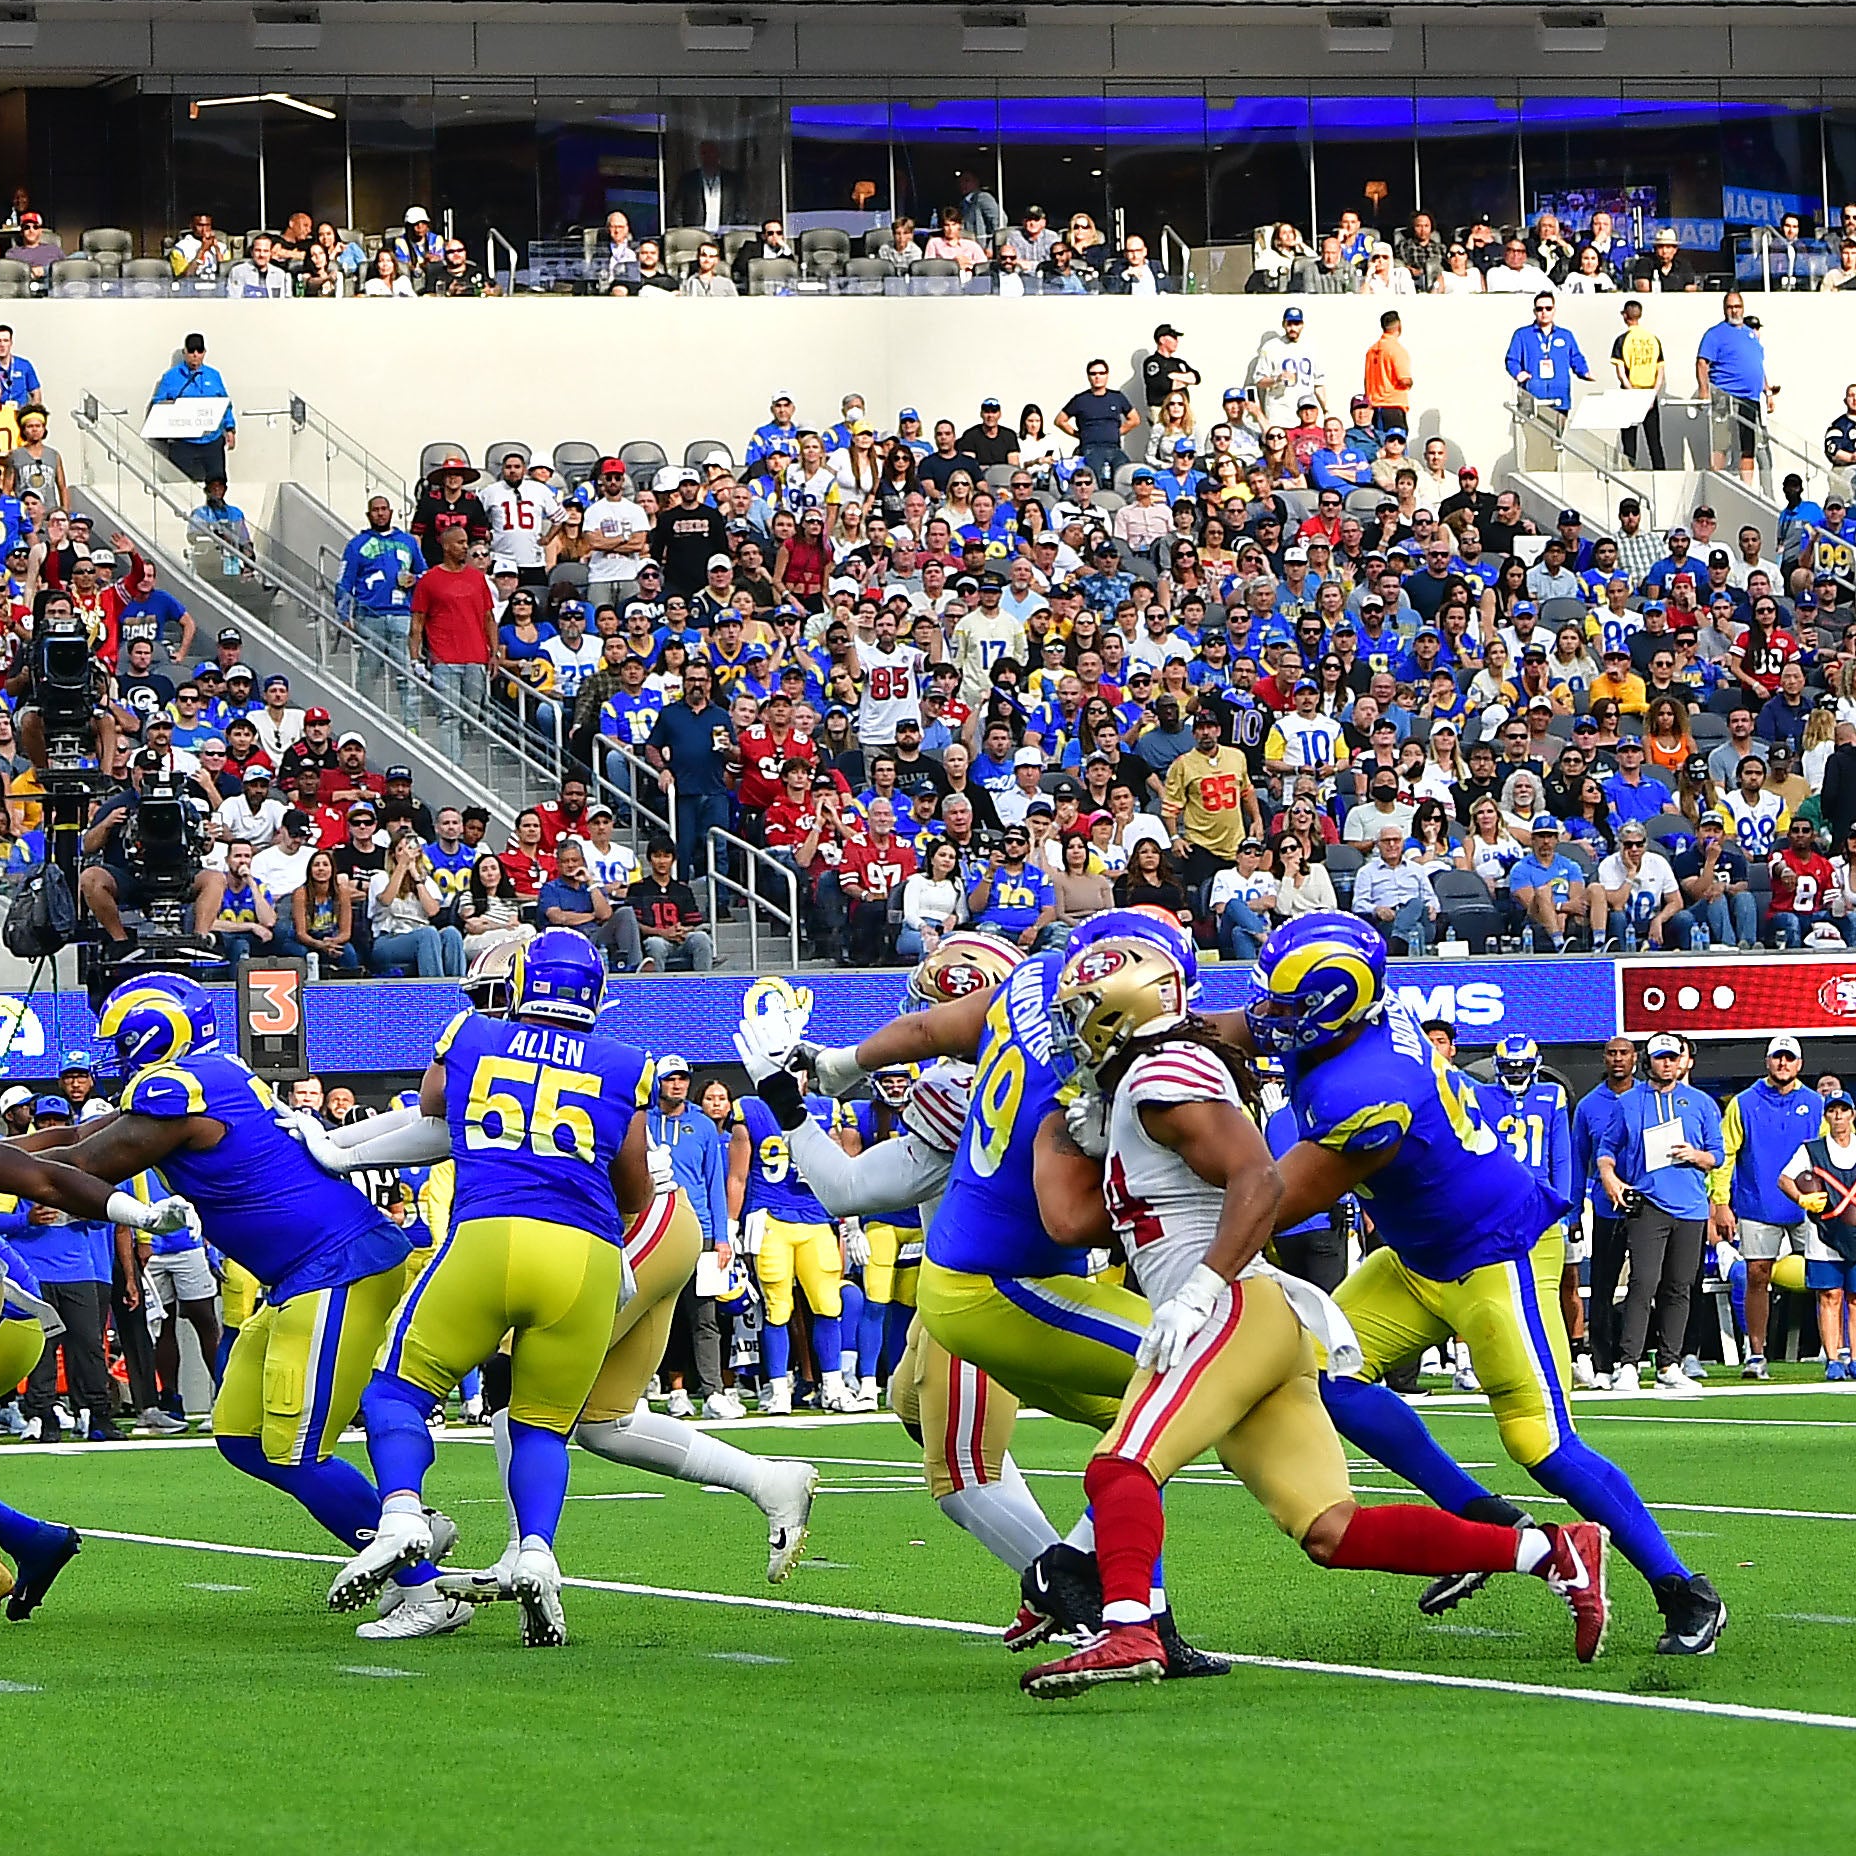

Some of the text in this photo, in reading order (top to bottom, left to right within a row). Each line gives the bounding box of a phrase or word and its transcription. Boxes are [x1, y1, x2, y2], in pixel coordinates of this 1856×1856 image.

[502, 501, 534, 530] 16
[980, 641, 1006, 667] 17
[871, 667, 908, 699] 85
[1300, 735, 1330, 765] 10
[1200, 776, 1236, 811] 85
[867, 867, 901, 895] 97
[1794, 876, 1815, 909] 8
[652, 903, 680, 929] 19
[249, 971, 299, 1034] 3
[1398, 982, 1505, 1025] MS
[509, 1030, 584, 1068] ALLEN
[465, 1055, 602, 1164] 55
[1497, 1114, 1544, 1166] 31
